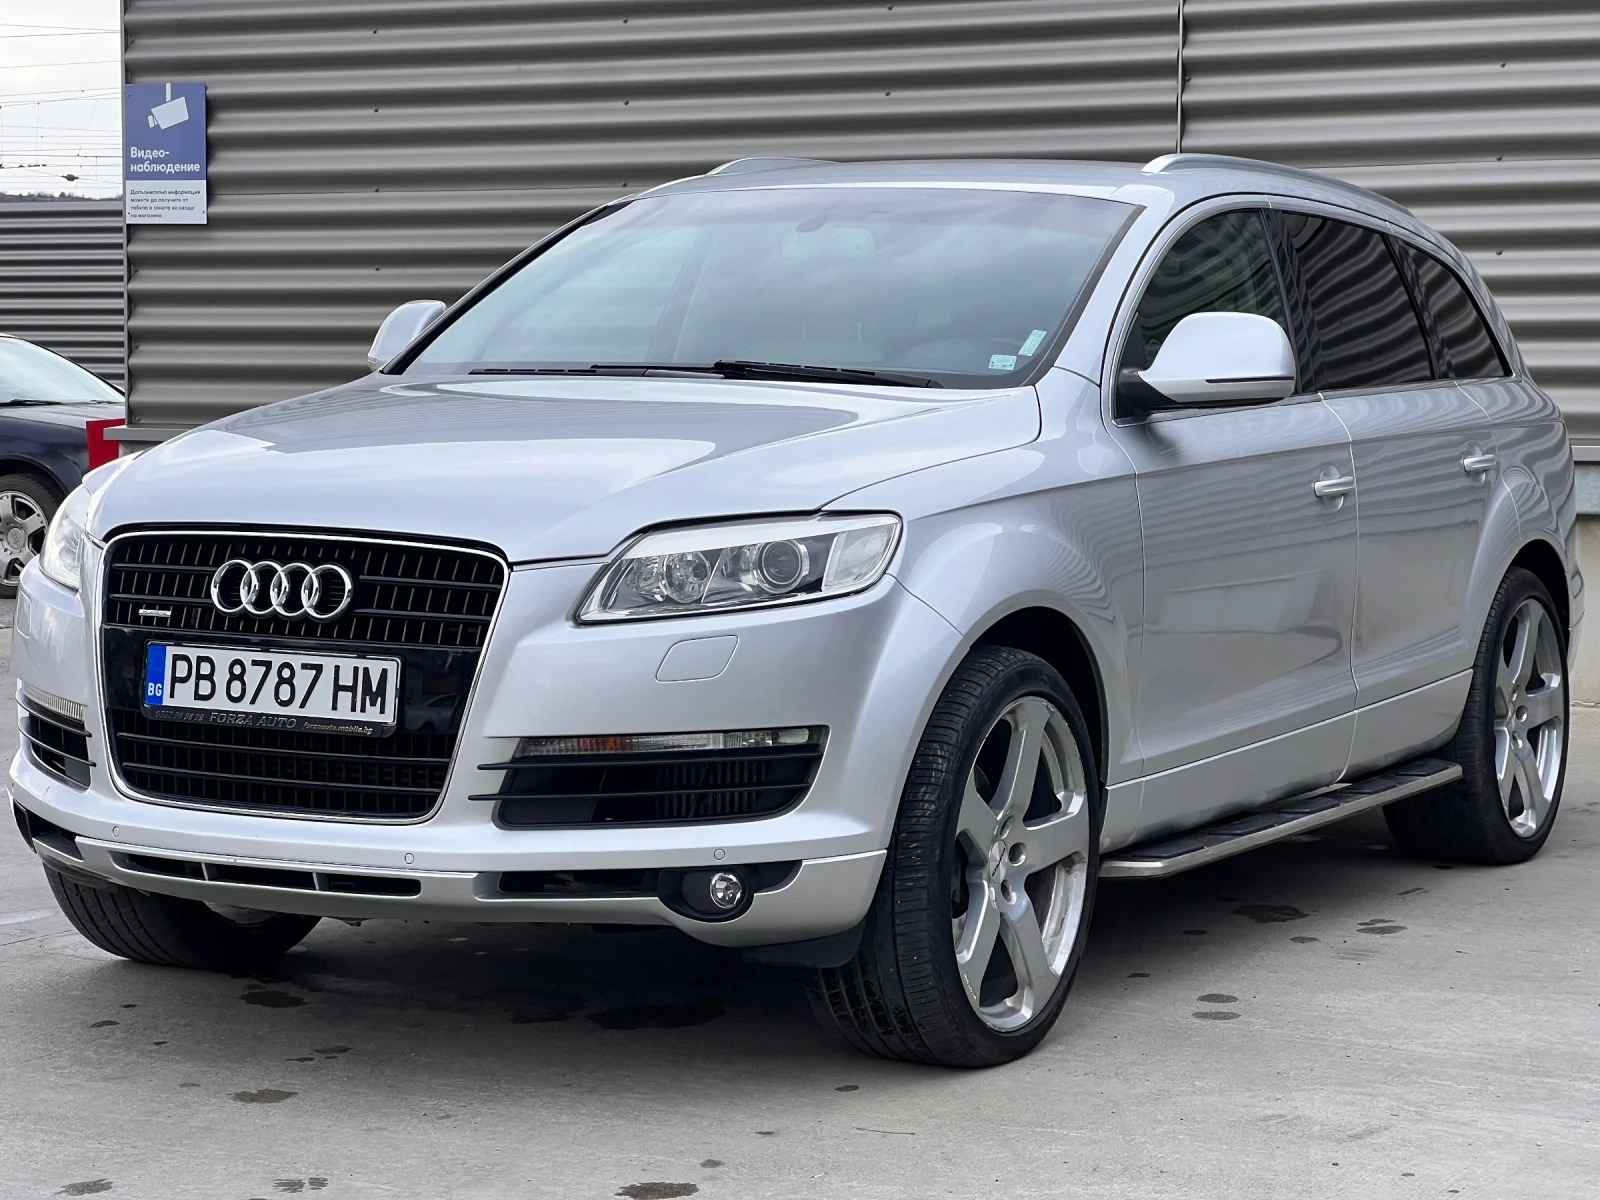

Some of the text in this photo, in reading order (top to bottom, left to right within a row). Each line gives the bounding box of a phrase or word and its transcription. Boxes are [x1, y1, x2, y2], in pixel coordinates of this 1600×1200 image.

[130, 146, 170, 160] Видео-
[130, 160, 200, 174] наблюдение
[147, 682, 163, 696] BG
[169, 653, 389, 715] PB 8787 HM
[209, 712, 253, 726] FORZA
[256, 715, 297, 729] AUTO
